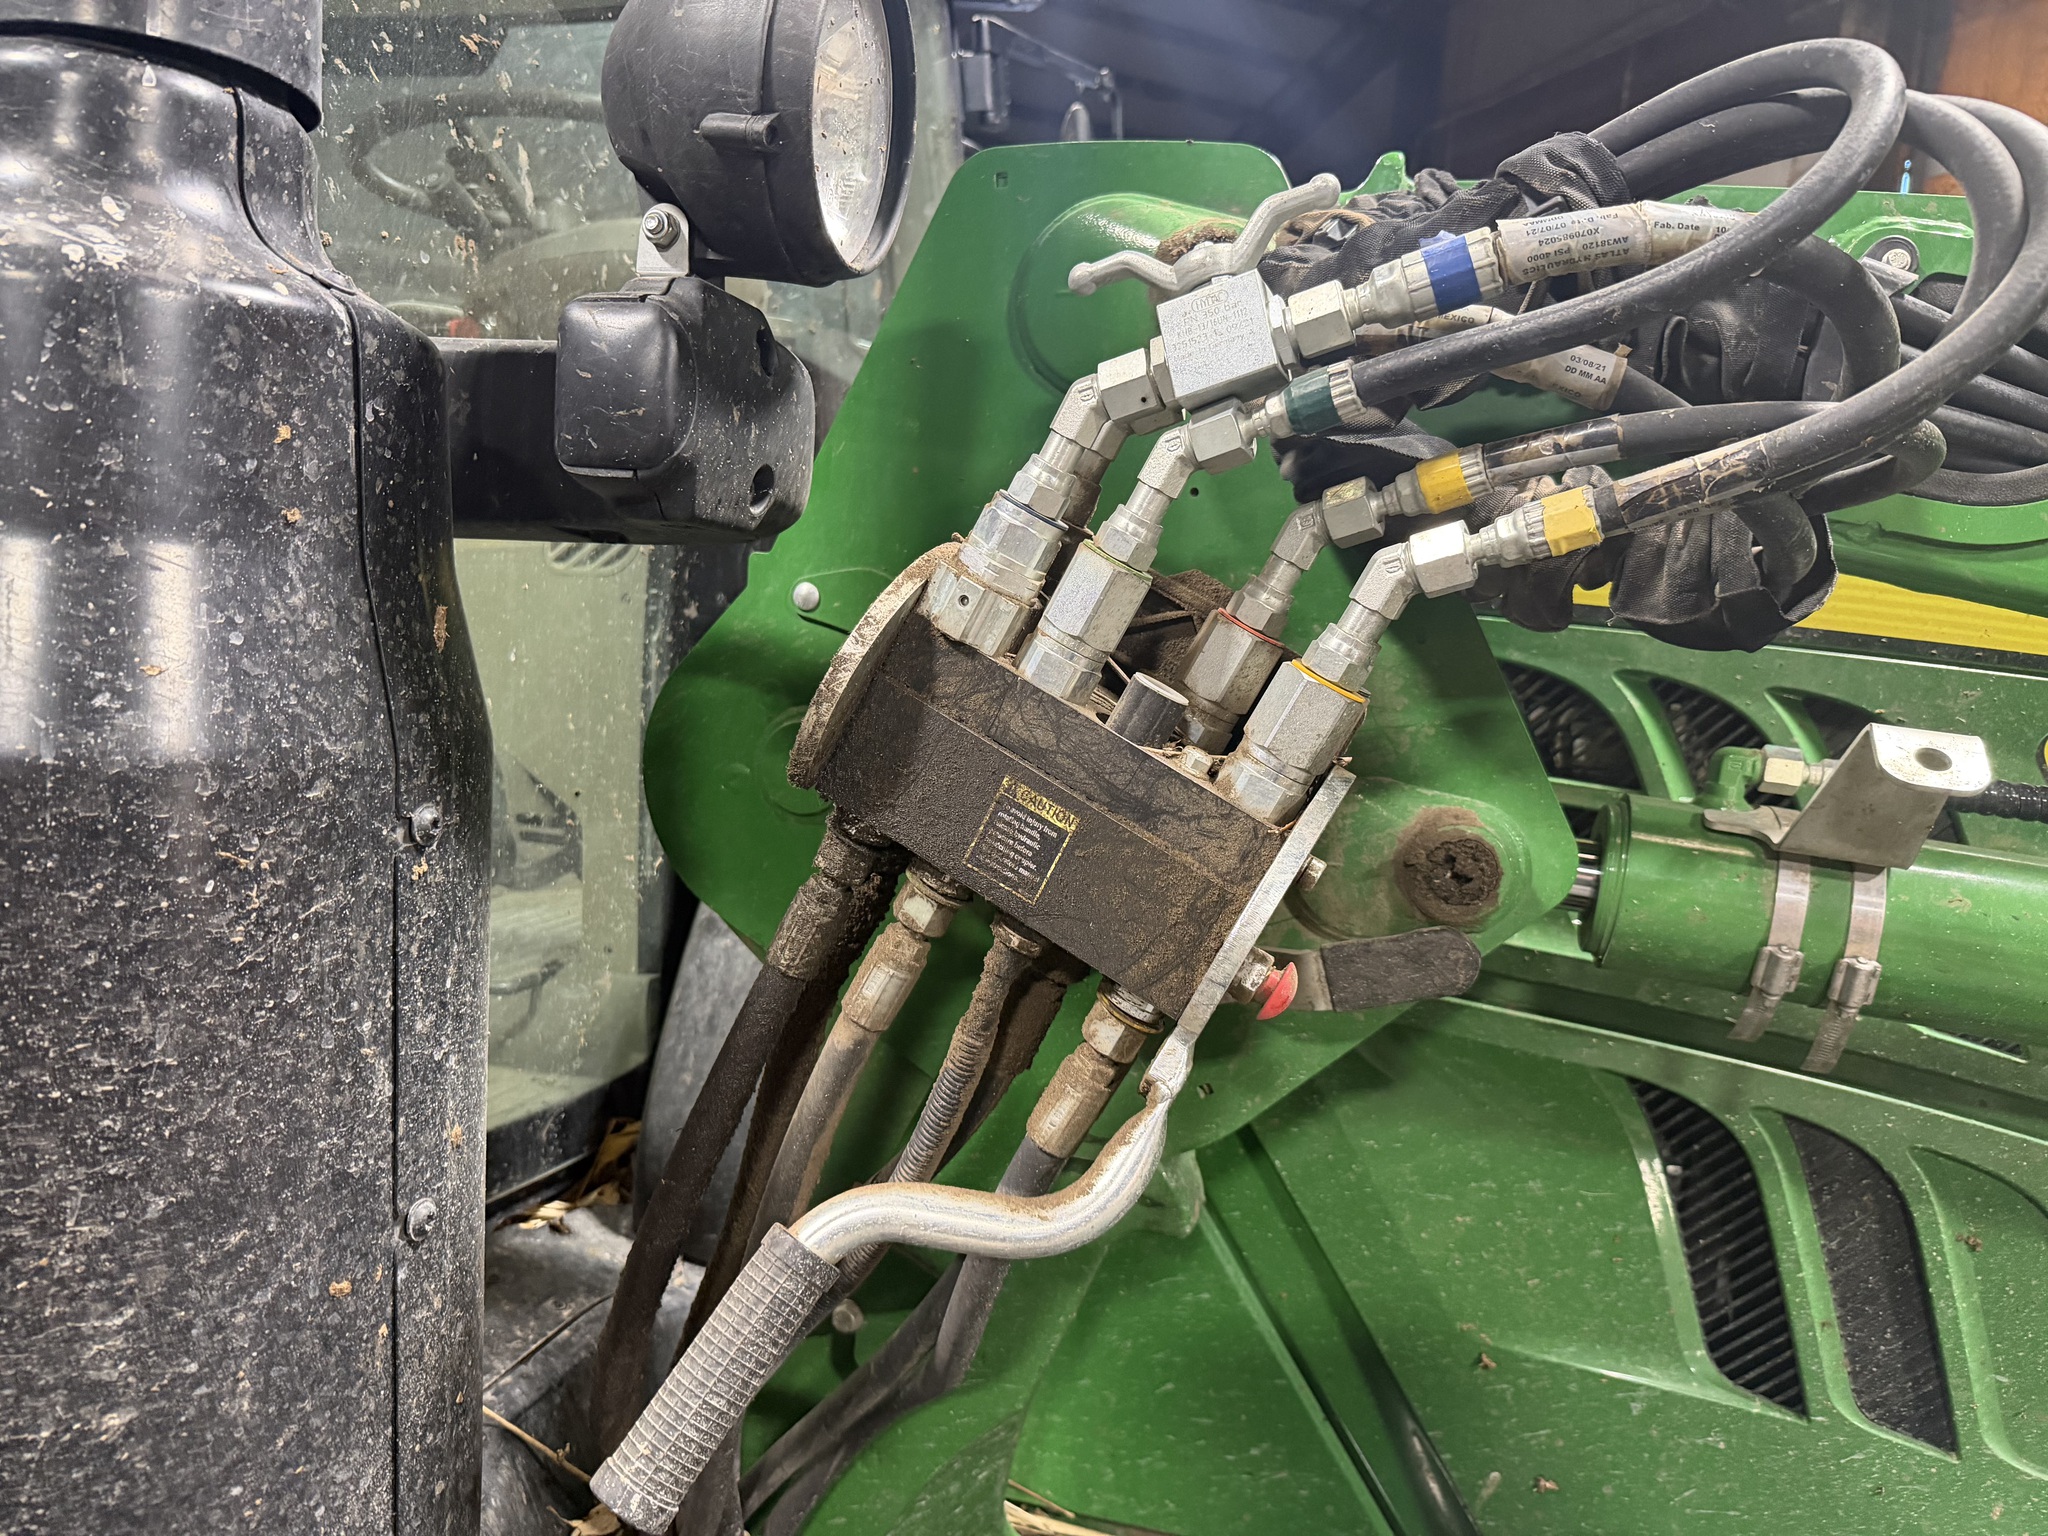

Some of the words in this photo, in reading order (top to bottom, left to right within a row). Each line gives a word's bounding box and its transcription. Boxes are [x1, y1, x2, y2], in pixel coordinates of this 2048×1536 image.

[1525, 221, 1567, 236] 07/07/21
[1571, 216, 1594, 227] Dte
[1653, 221, 1675, 230] Fab.
[1677, 222, 1700, 231] Date
[1538, 227, 1601, 247] X070985024
[1581, 235, 1629, 251] AW38120
[1526, 251, 1552, 263] 4000
[1553, 246, 1571, 257] PSI
[1594, 247, 1631, 260] ATLAS
[1521, 253, 1592, 276] HYDRAULICS
[1201, 306, 1221, 320] 350
[1223, 298, 1243, 311] bar
[1569, 354, 1607, 372] 03/08/21
[1564, 365, 1578, 375] DD
[1577, 369, 1594, 380] MM
[1593, 375, 1607, 385] AA
[1019, 789, 1076, 828] CAUTION
[1042, 825, 1059, 839] from
[1013, 842, 1033, 857] before
